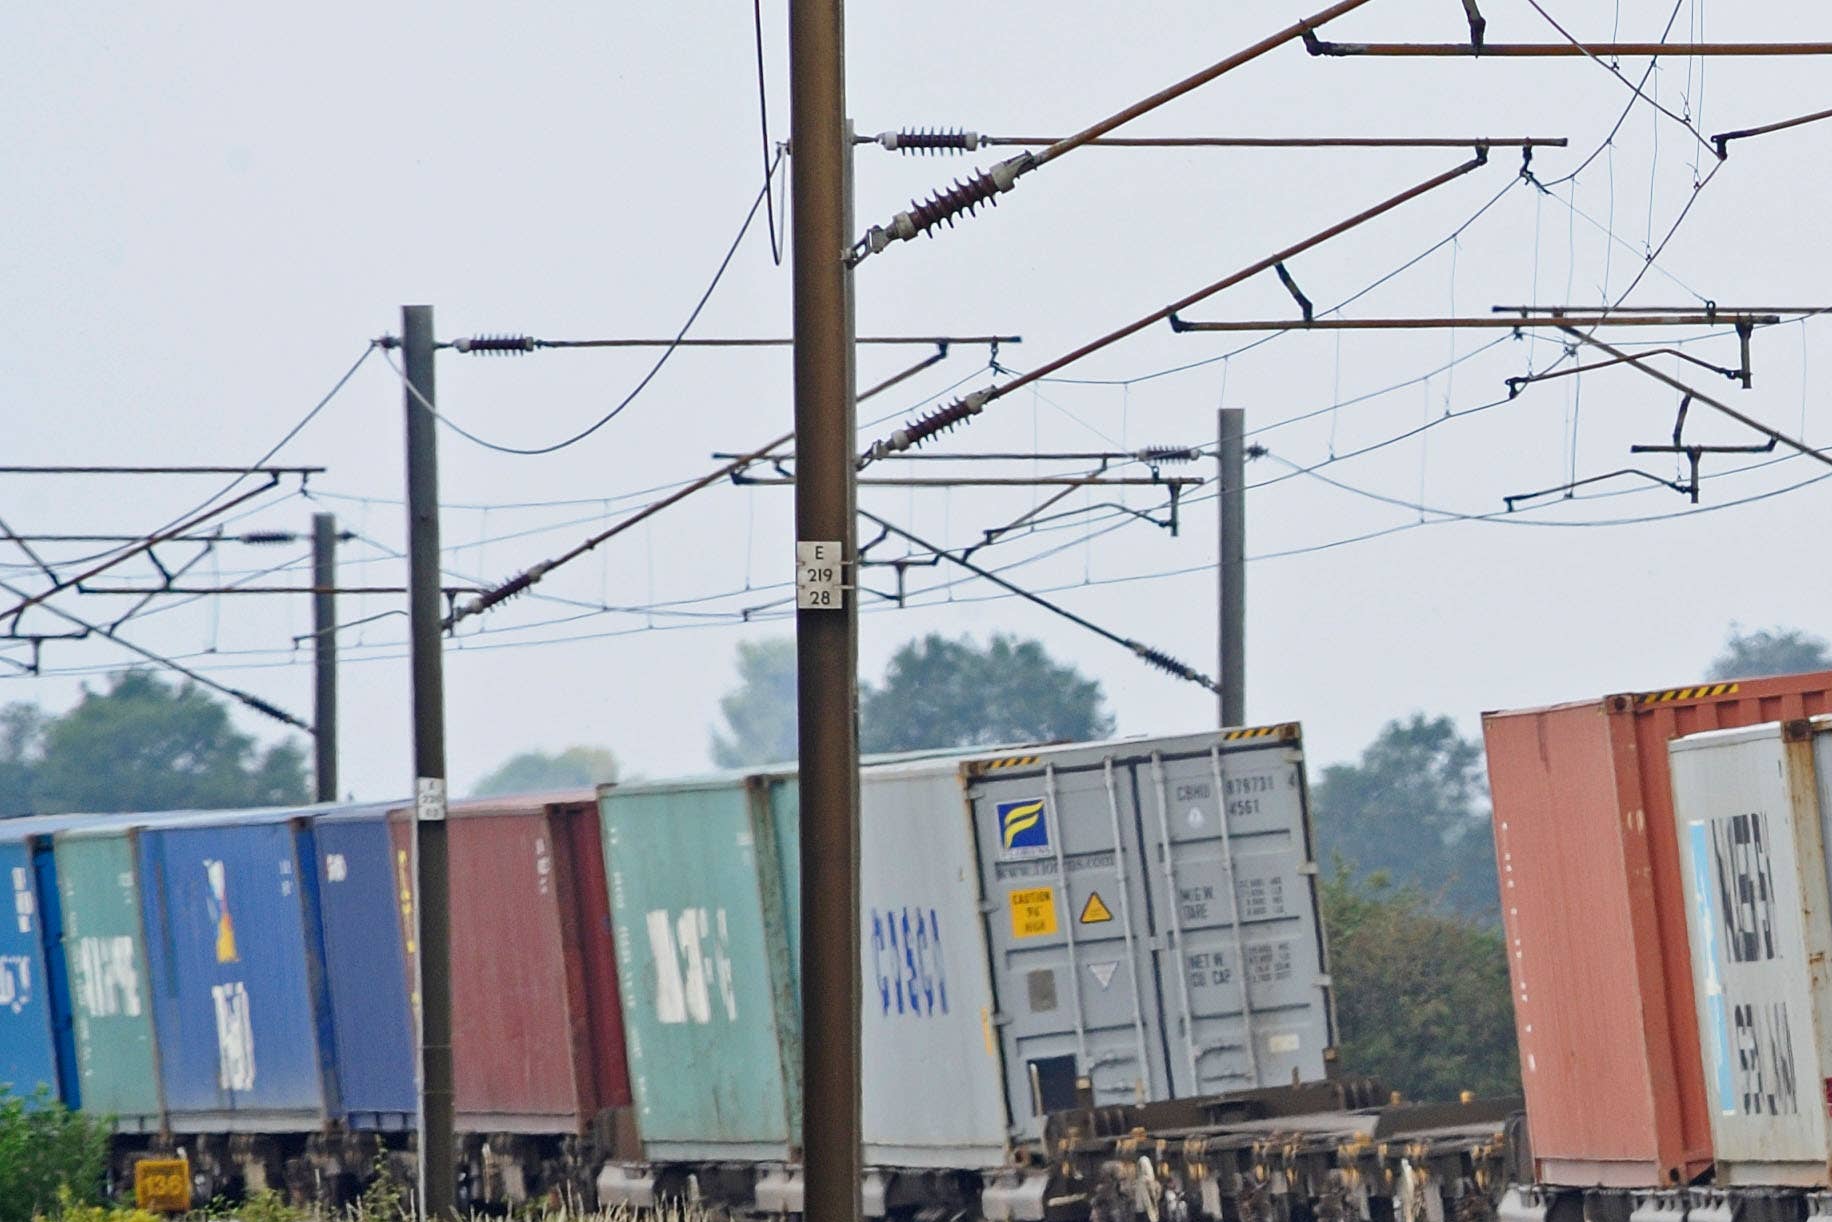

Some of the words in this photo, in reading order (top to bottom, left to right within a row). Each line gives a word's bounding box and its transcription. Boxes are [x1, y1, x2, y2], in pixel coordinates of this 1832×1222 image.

[815, 546, 824, 560] E
[807, 569, 832, 582] 219
[809, 591, 830, 605] 28
